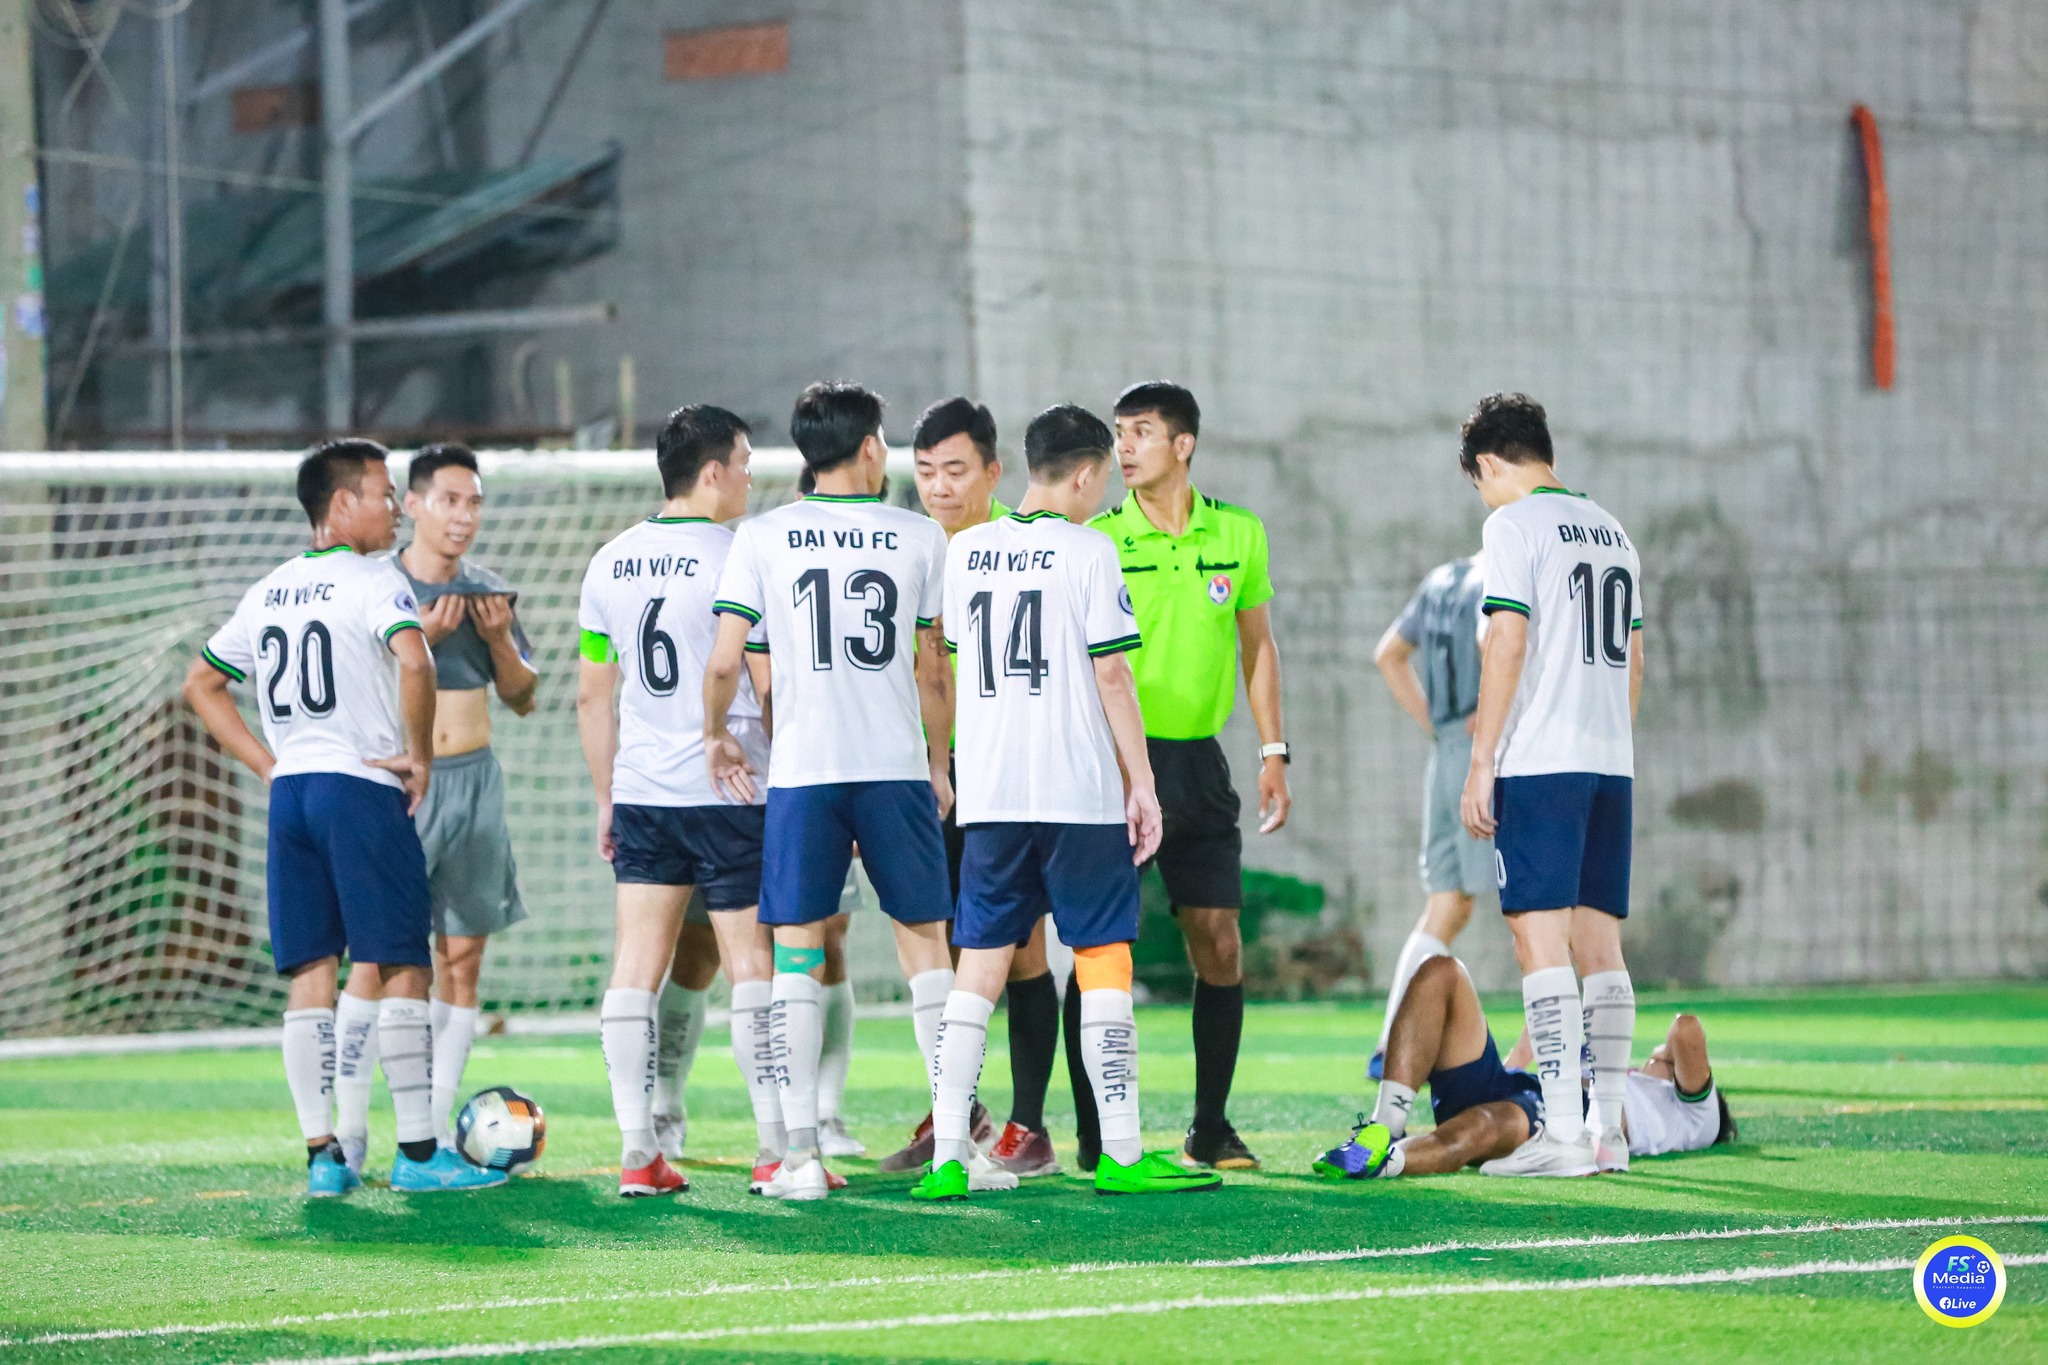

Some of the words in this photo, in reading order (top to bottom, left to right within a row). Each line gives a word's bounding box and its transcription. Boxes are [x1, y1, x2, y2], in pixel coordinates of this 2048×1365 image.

[787, 529, 825, 551] ĐẠI
[833, 528, 864, 549] VŨ
[872, 531, 898, 550] FC
[1558, 524, 1588, 547] ĐẠI
[613, 558, 642, 582] ĐẠI
[674, 557, 699, 577] FC
[967, 550, 1000, 575] ĐẠI
[1031, 550, 1055, 570] FC
[313, 583, 335, 601] FC
[793, 568, 898, 671] 13
[1569, 562, 1633, 668] 10
[637, 598, 679, 697] 6
[968, 590, 1049, 697] 14
[258, 620, 337, 724] 20
[1097, 1028, 1131, 1055] ĐẠI
[1101, 1058, 1131, 1080] VŨ
[1538, 1060, 1561, 1080] FC
[1104, 1083, 1126, 1103] FC
